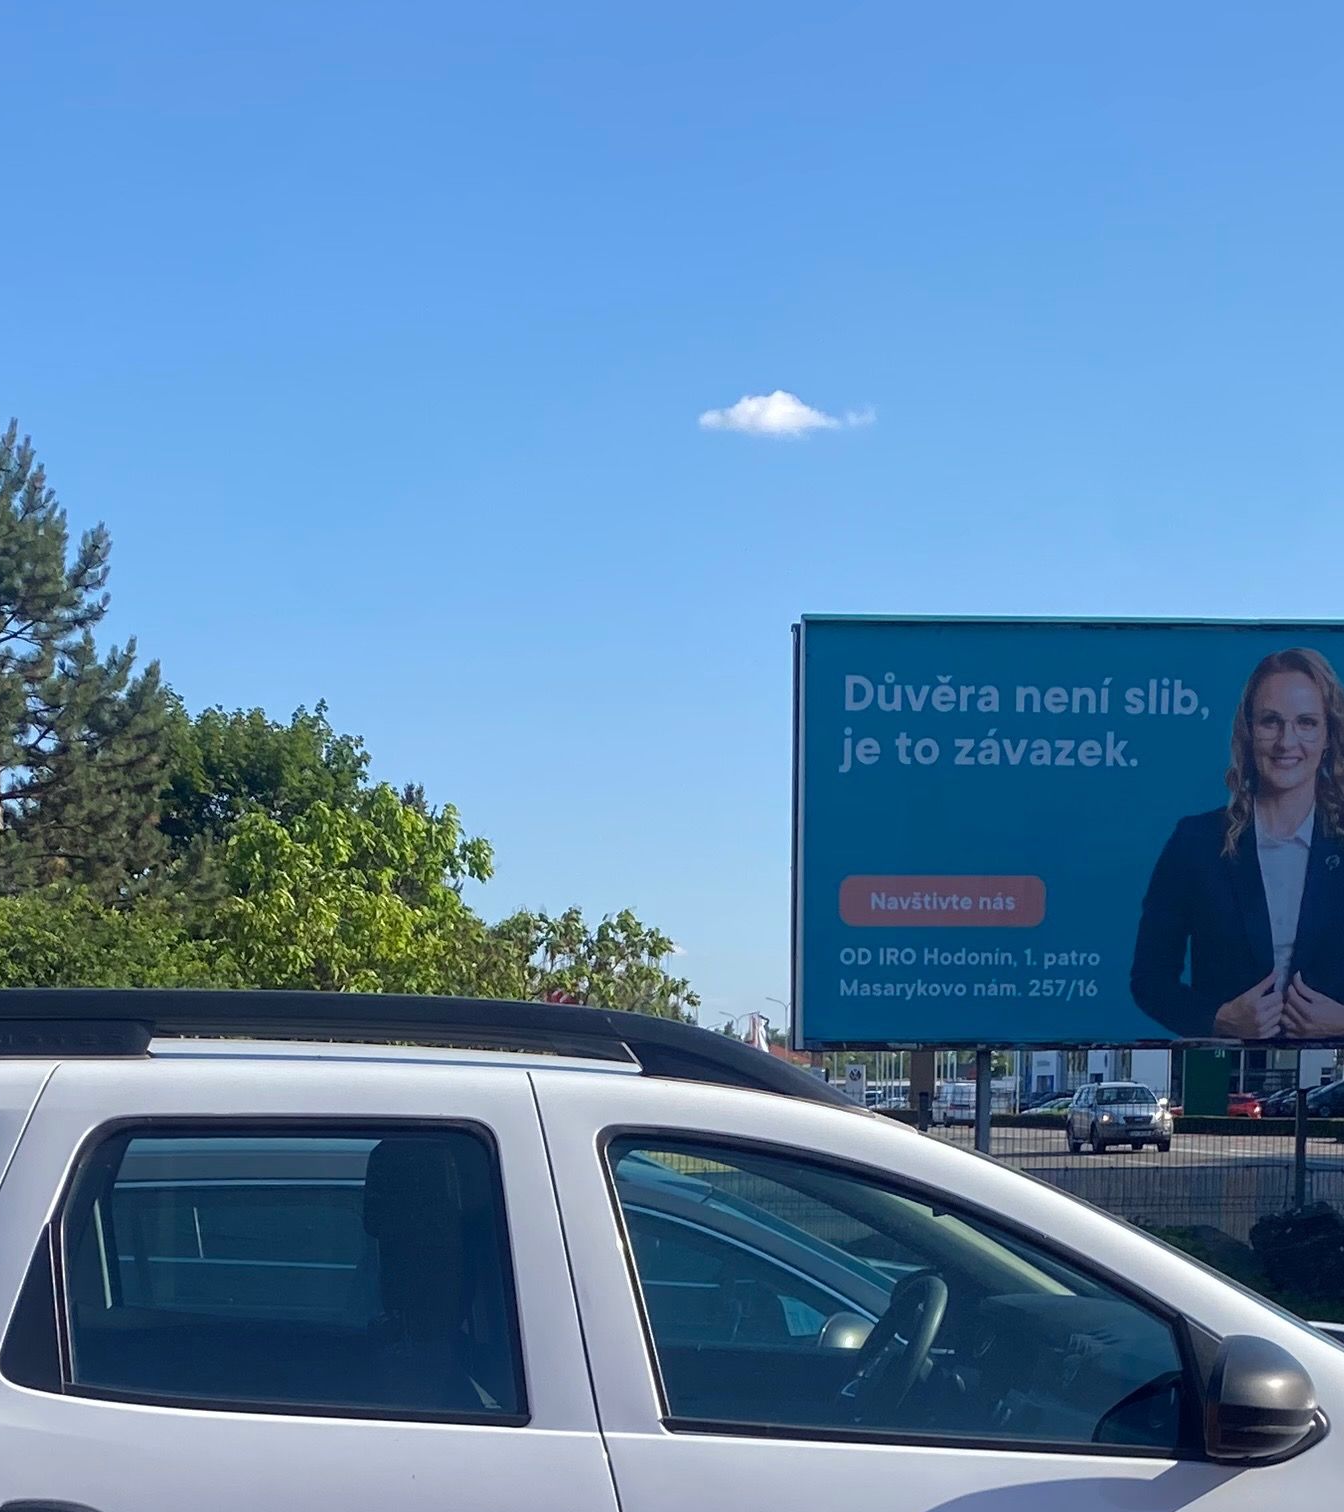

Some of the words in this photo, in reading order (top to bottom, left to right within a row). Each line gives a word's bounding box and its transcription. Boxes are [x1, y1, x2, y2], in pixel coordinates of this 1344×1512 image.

[844, 671, 1000, 713] Důvěra
[1016, 677, 1113, 715] není
[1124, 678, 1210, 721] slib,
[838, 727, 881, 774] je
[895, 731, 940, 766] to
[953, 728, 1139, 767] závazek.
[870, 891, 973, 911] Navštivte
[978, 891, 1016, 911] nás
[839, 948, 872, 966] OD
[879, 948, 917, 966] IRO
[923, 948, 1018, 968] Hodonín,
[1024, 949, 1038, 966] 1.
[1043, 950, 1101, 970] patro
[839, 978, 968, 1001] Masarykovo
[972, 978, 1022, 997] nám.
[1027, 979, 1099, 1001] 257/16
